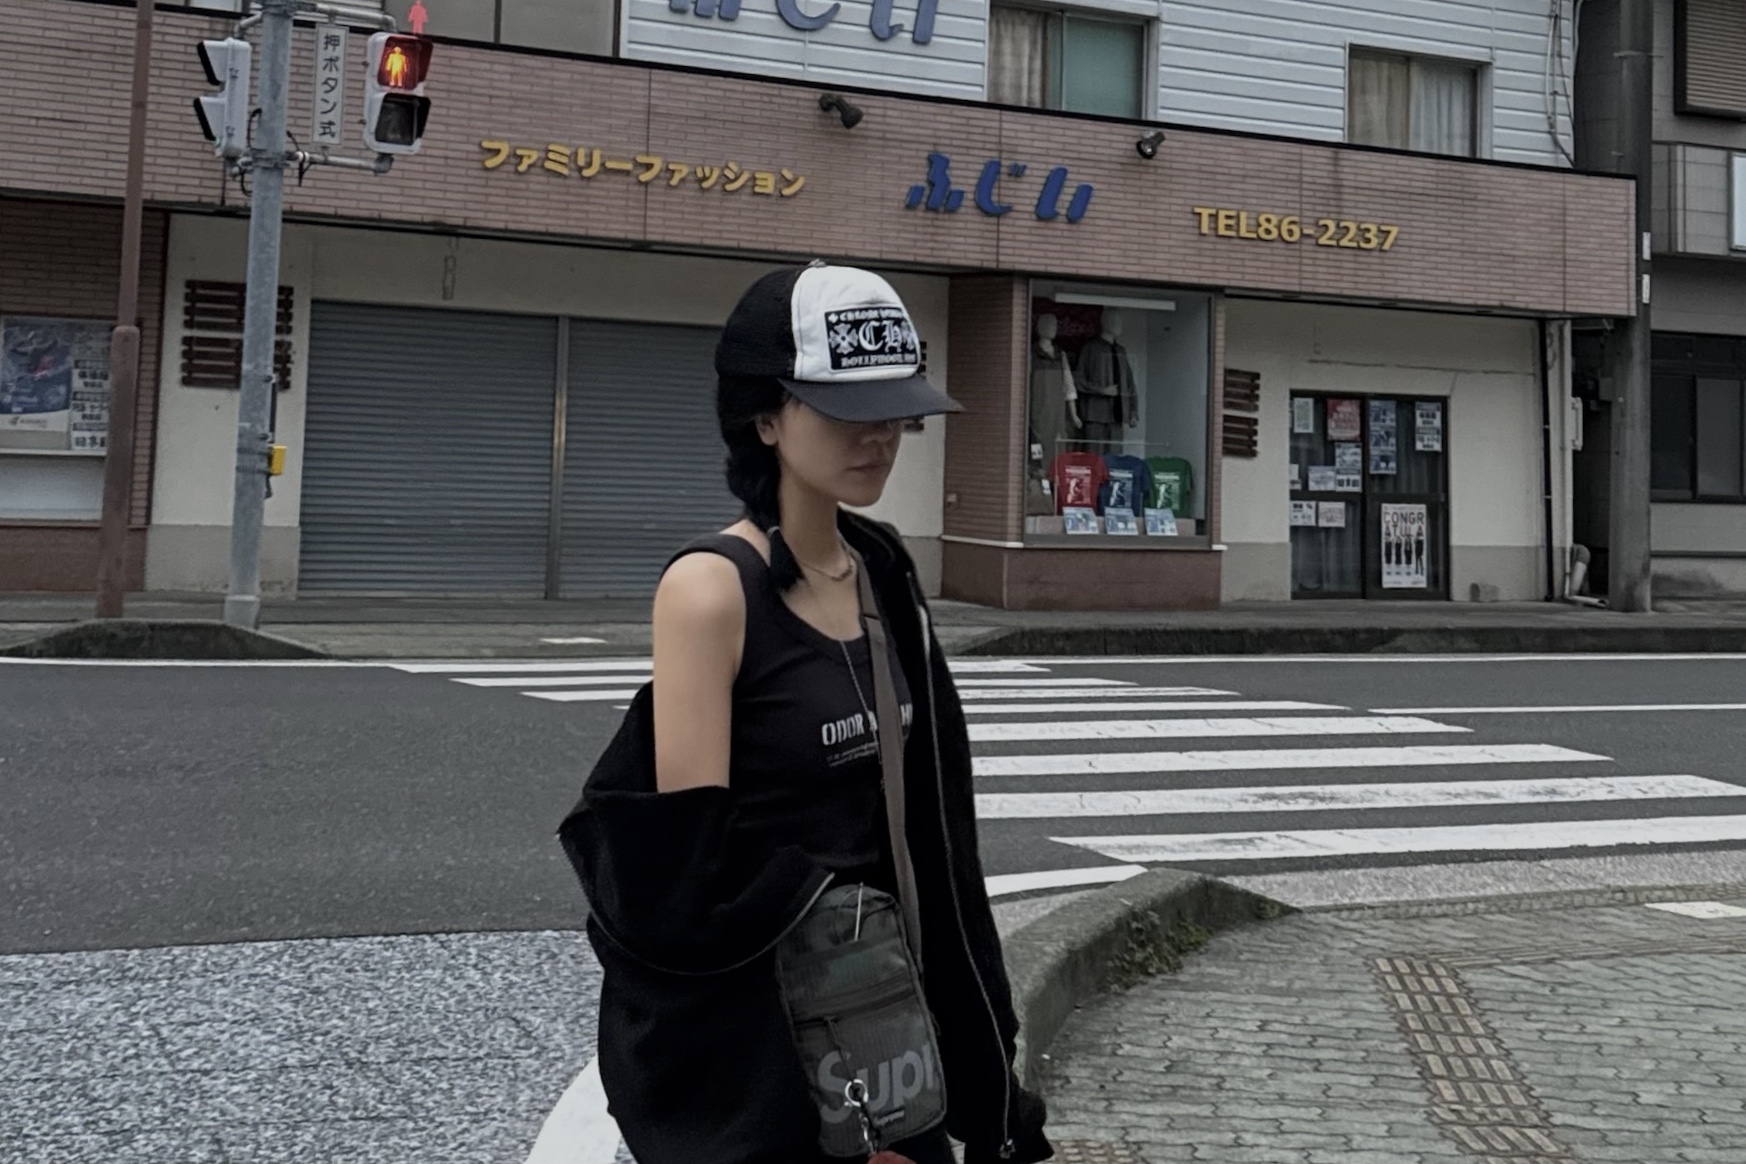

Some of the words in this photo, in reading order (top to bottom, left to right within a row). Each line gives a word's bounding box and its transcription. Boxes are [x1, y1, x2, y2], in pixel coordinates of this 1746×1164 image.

[319, 33, 340, 138] 押ボタン式
[481, 139, 805, 197] ファミリーファッション
[906, 152, 1094, 223] ふじい
[1193, 206, 1399, 250] TEL86-2237
[1383, 511, 1425, 526] CONGR
